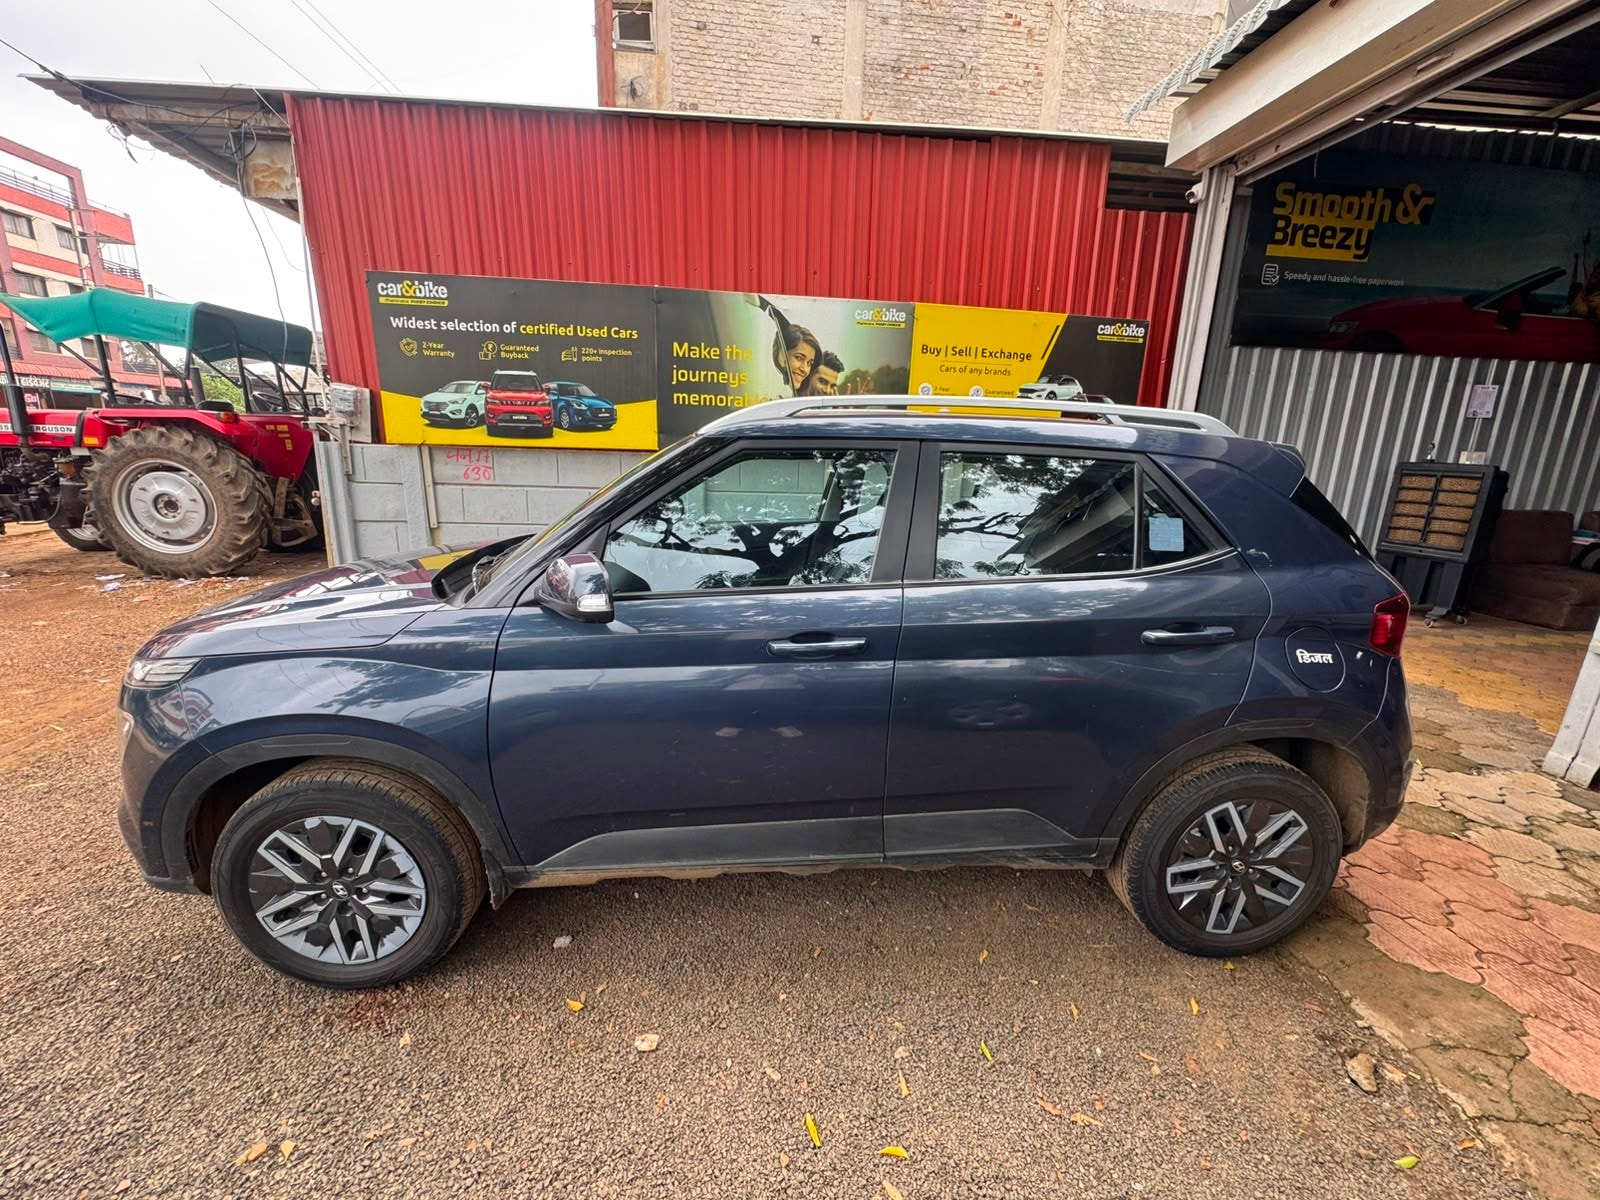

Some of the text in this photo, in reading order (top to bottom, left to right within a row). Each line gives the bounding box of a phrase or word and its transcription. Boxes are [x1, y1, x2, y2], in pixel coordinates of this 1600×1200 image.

[1272, 182, 1436, 225] Smooth &
[1273, 214, 1375, 260] Breezy
[1283, 271, 1311, 282] Speedy
[1313, 273, 1326, 281] and
[1328, 273, 1366, 284] hassle-free
[377, 280, 448, 298] car&bike
[855, 307, 906, 321] car&bike
[390, 316, 638, 339] Widest selection of certified Used Cars
[1097, 323, 1145, 337] car&bike
[422, 341, 444, 349] 2-Year
[500, 343, 539, 352] Guaranteed
[581, 347, 597, 355] 220+
[672, 341, 753, 360] Make the
[423, 349, 455, 358] Warranty
[501, 351, 529, 360] Buyback
[921, 344, 942, 357] Buy
[951, 346, 971, 357] Sell
[981, 348, 1032, 362] Exchange
[671, 364, 749, 387] journeys
[939, 364, 1011, 376] Cars of any brands
[1296, 648, 1333, 664] डिजल
